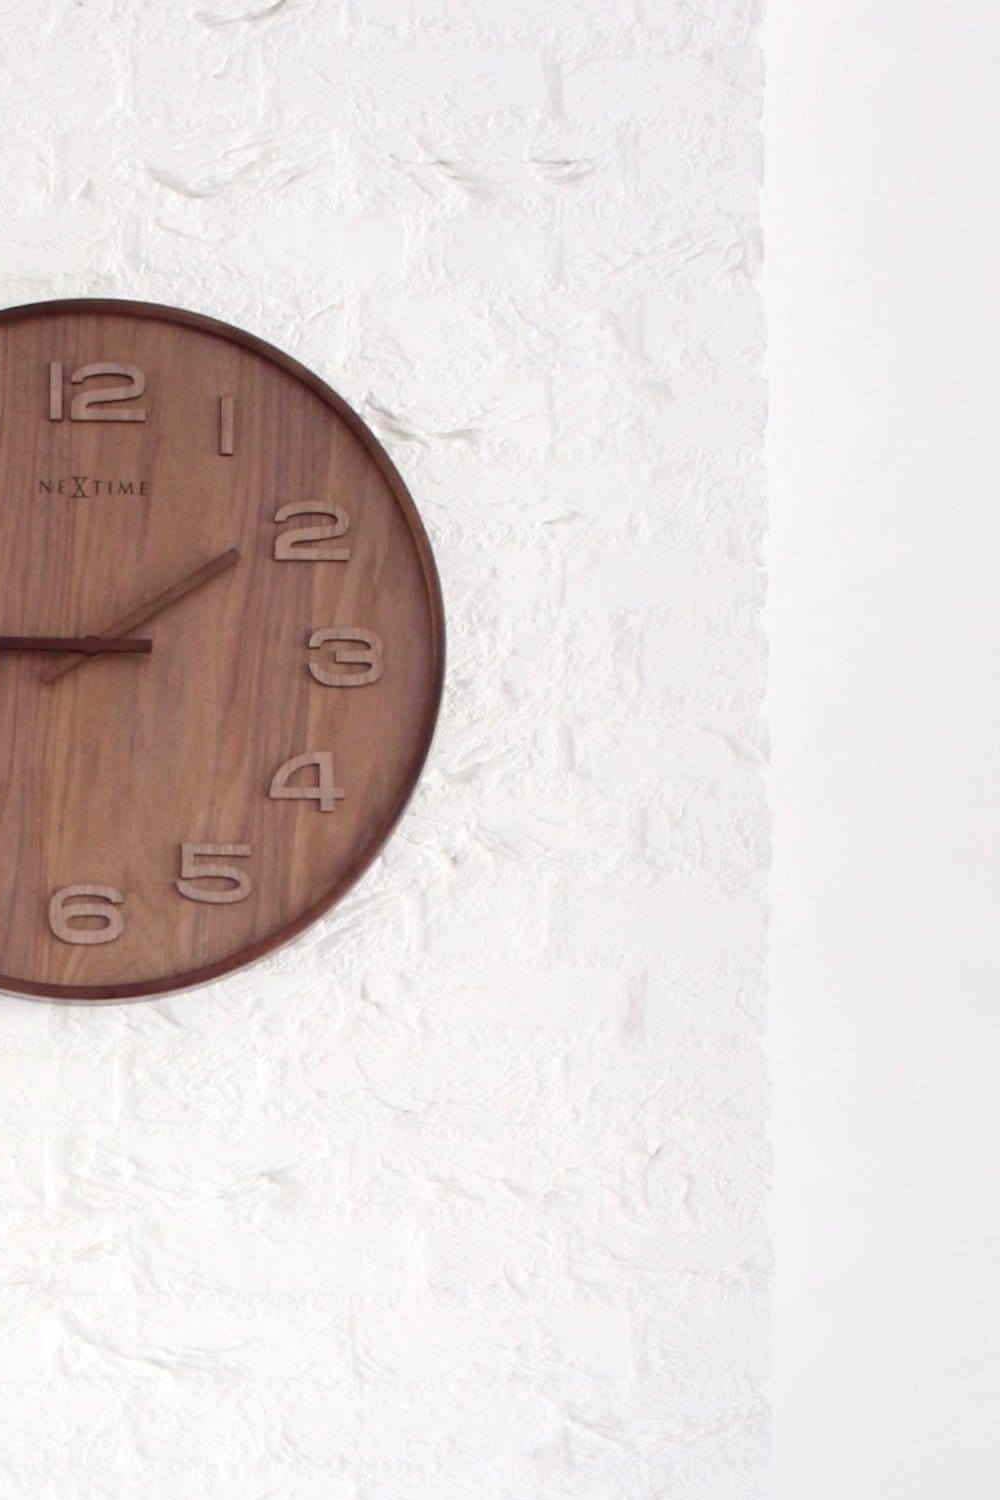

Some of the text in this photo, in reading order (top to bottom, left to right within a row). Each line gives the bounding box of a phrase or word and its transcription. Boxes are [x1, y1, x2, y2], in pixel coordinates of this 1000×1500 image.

[48, 361, 146, 422] 12
[219, 395, 234, 455] 1
[274, 500, 350, 561] 2
[307, 627, 383, 687] 3
[269, 751, 345, 812] 4
[175, 842, 251, 903] 5
[48, 884, 125, 945] 6
